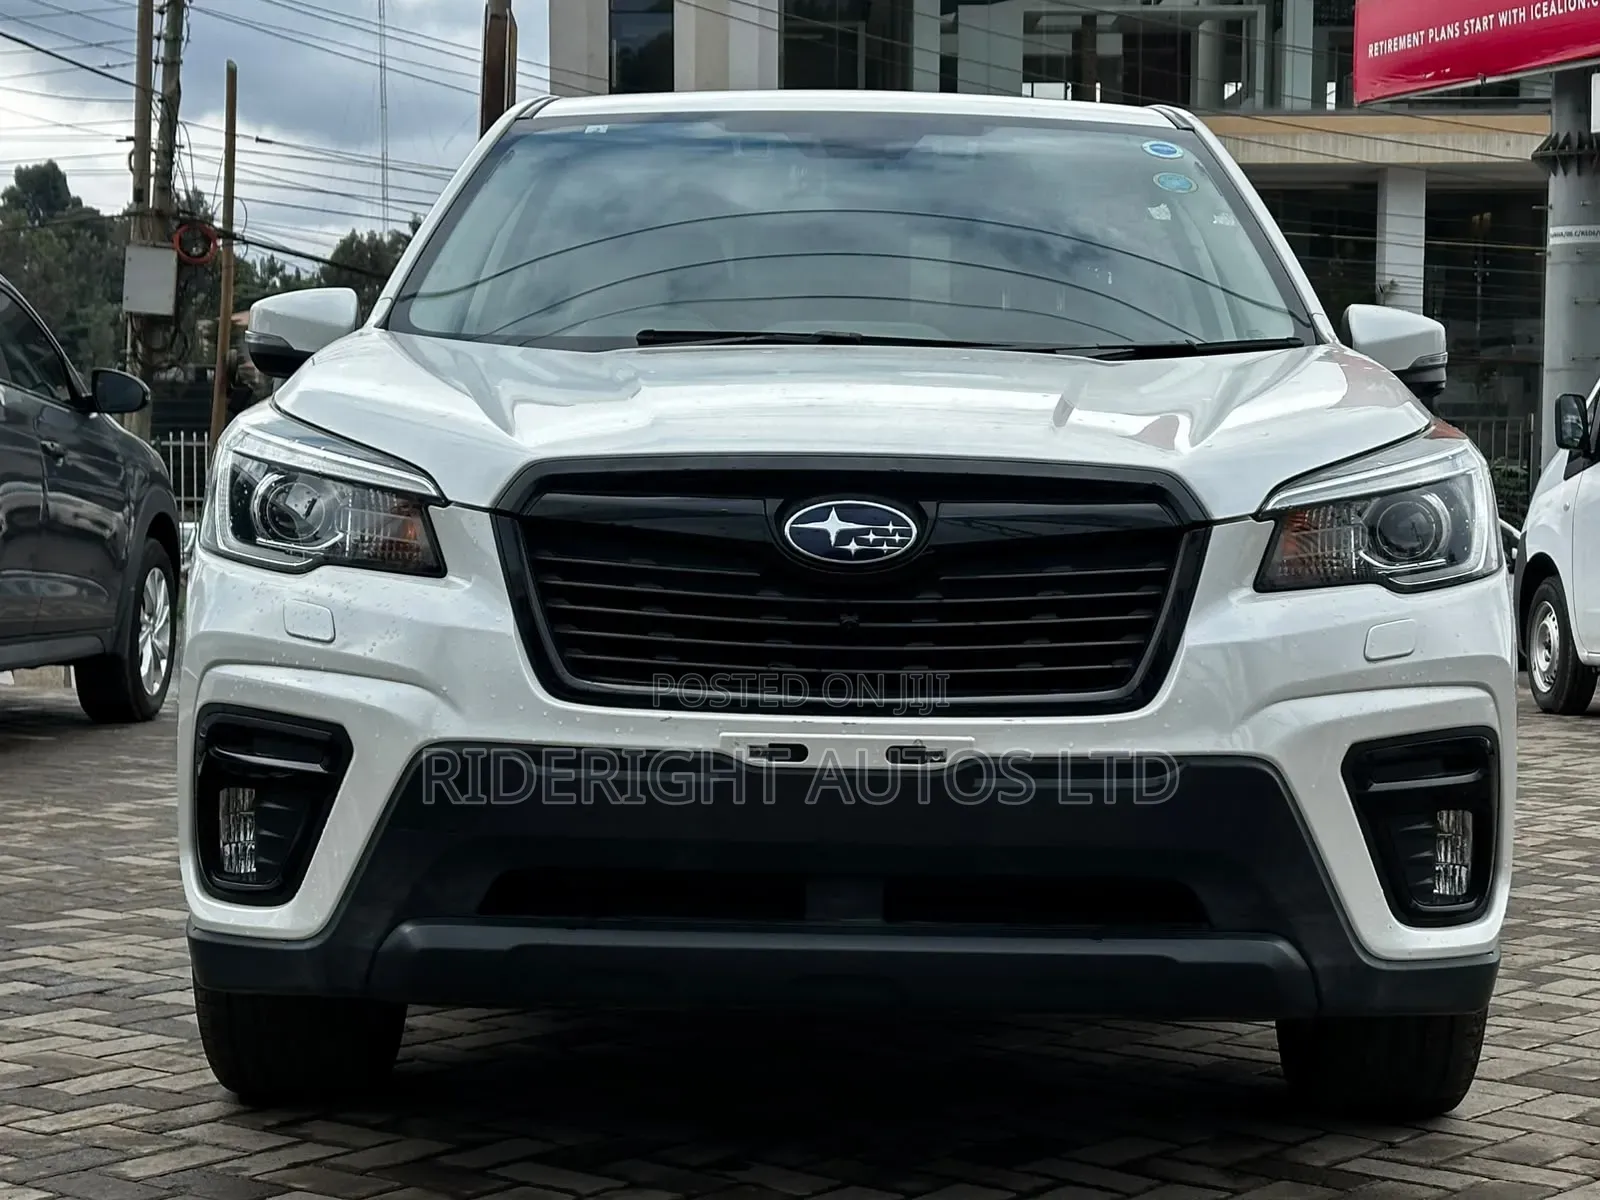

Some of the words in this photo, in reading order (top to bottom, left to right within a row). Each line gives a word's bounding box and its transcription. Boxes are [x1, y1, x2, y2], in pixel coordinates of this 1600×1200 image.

[1368, 30, 1425, 58] RETIREMENT
[1428, 21, 1460, 43] PLANS
[1463, 13, 1495, 36] START
[1498, 6, 1526, 28] WITH
